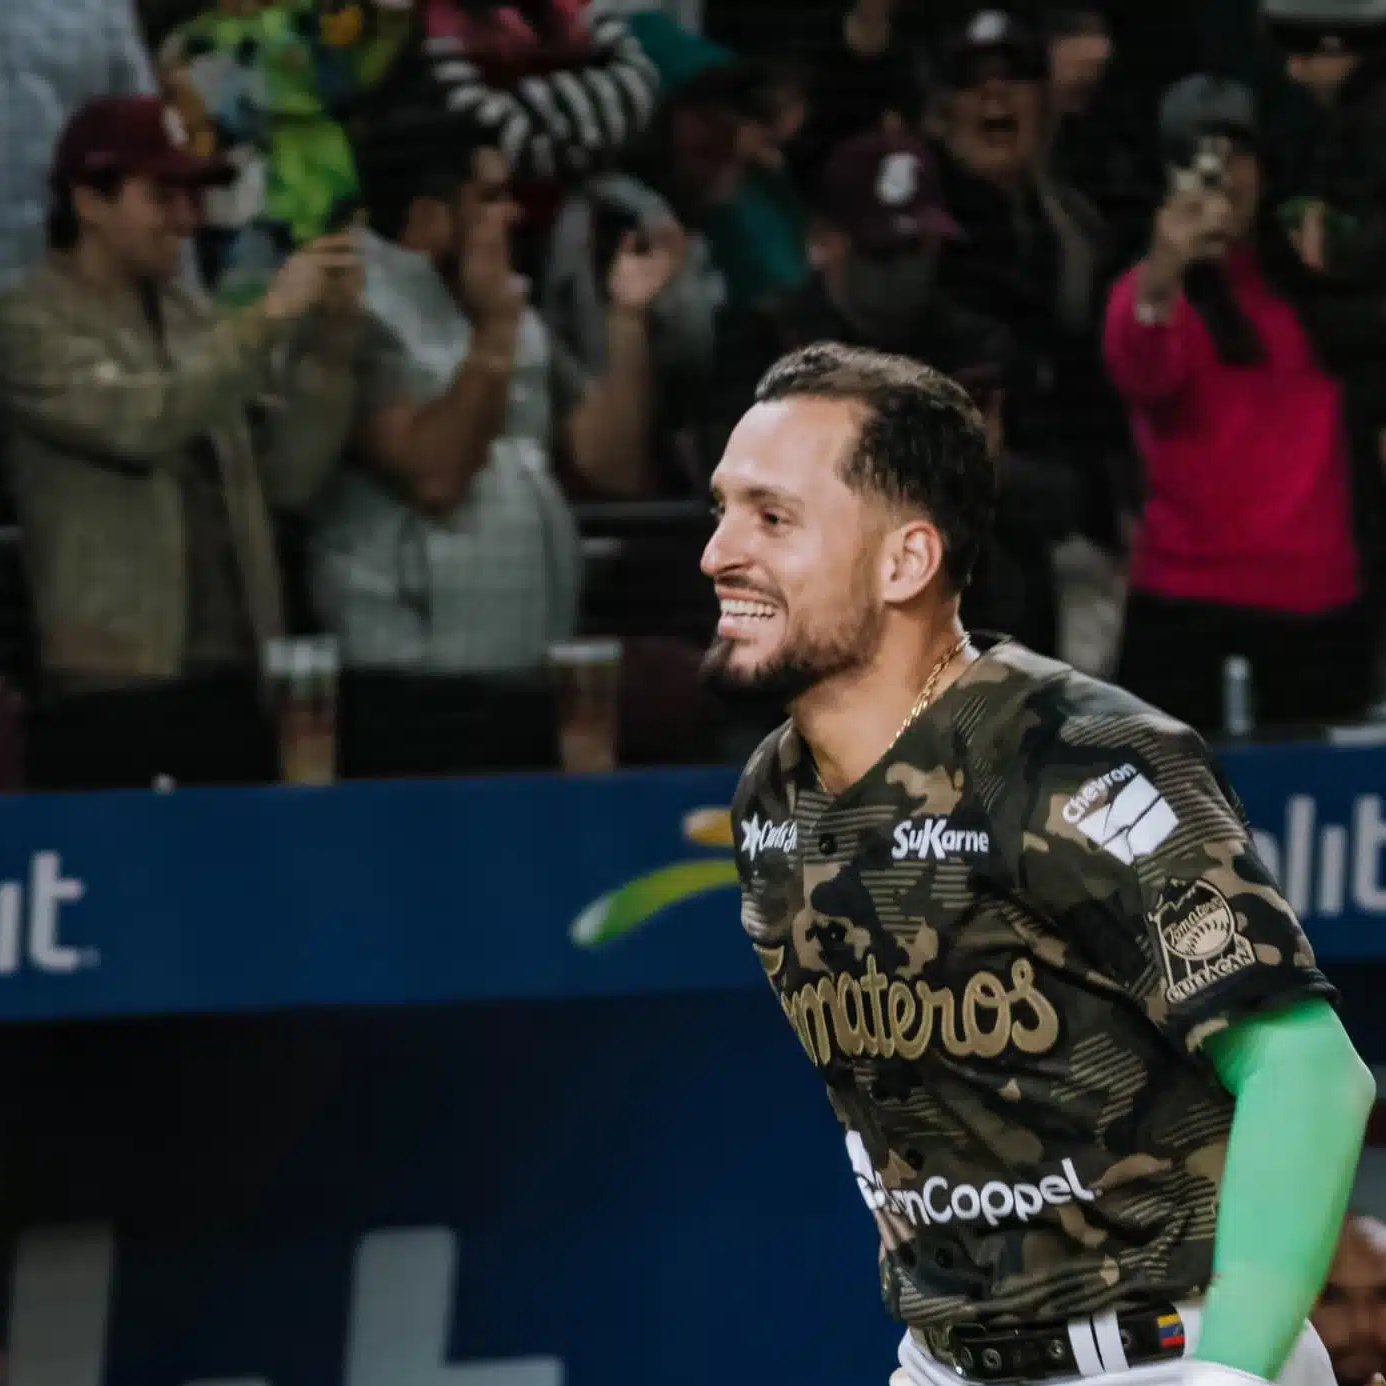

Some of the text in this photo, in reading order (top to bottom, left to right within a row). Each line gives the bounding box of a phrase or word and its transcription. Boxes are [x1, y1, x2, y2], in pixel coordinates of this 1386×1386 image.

[1062, 762, 1138, 824] Chevron
[891, 817, 990, 860] SuKarne
[753, 943, 1060, 1068] materos
[871, 1157, 1096, 1227] nCoppel
